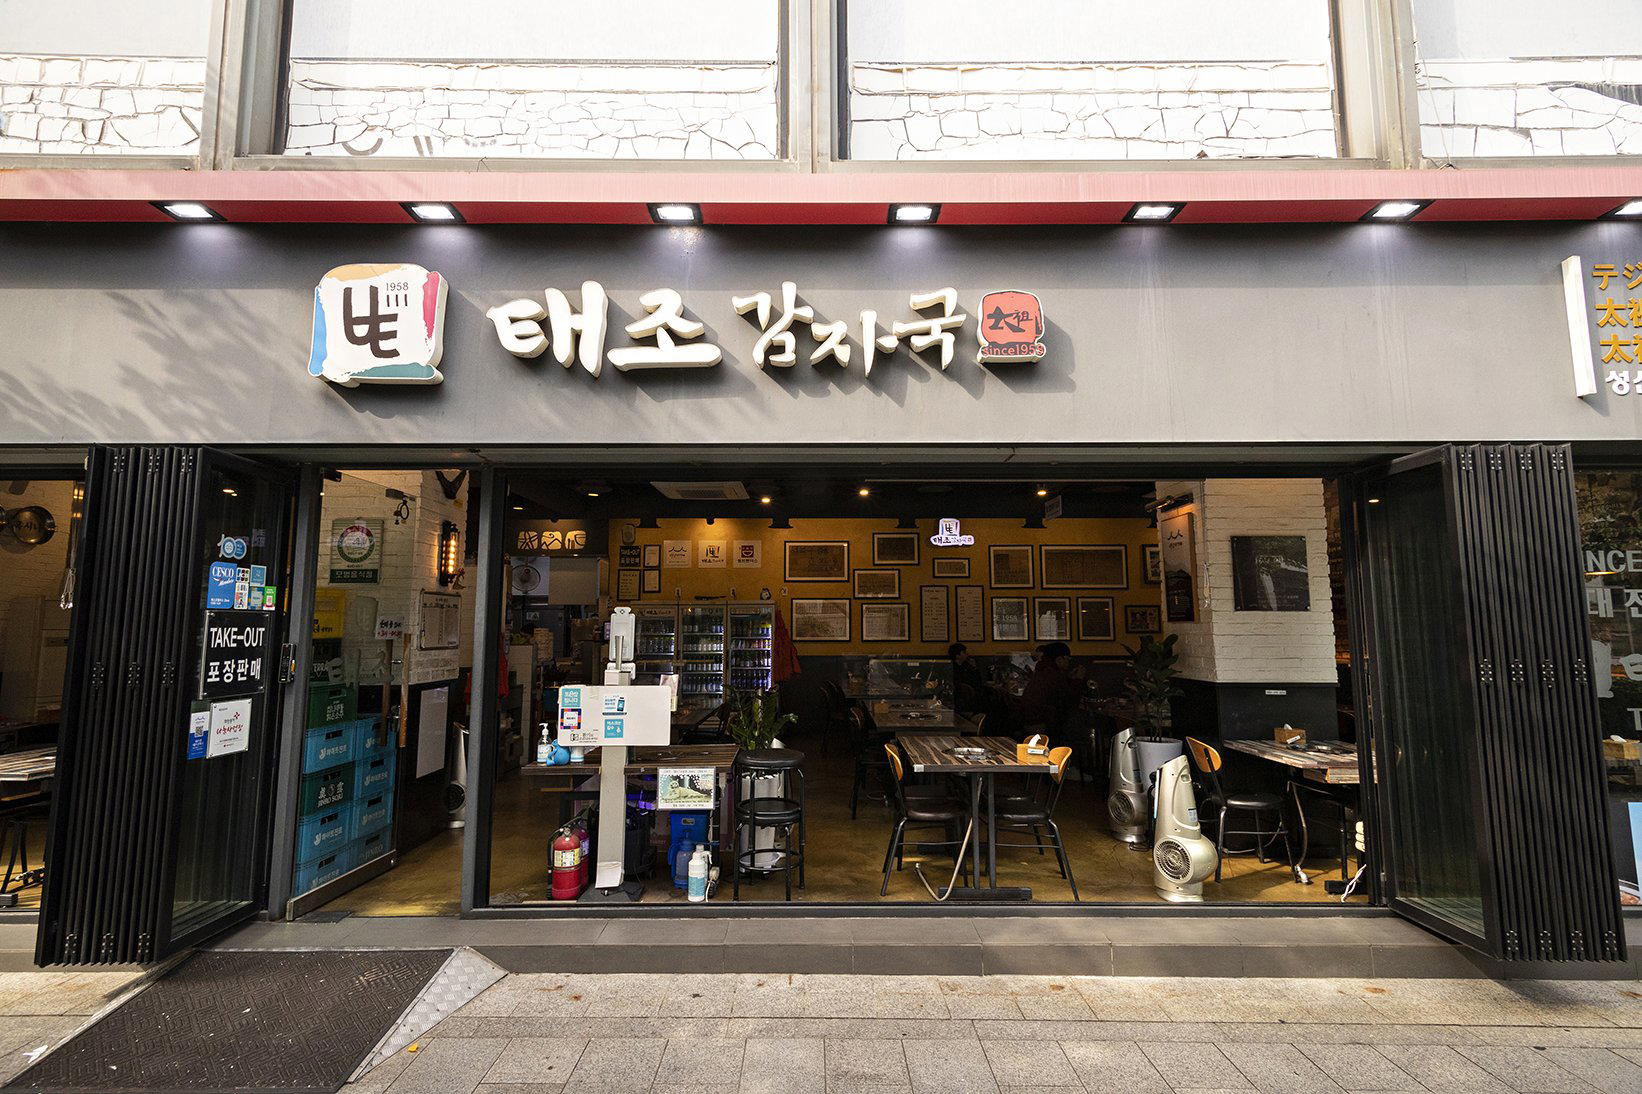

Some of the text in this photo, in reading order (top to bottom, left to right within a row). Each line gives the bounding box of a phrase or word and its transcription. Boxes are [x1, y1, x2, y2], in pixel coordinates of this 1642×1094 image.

[385, 281, 409, 291] 1958
[212, 566, 235, 578] CESCO
[209, 627, 266, 648] TAKE-OUT
[206, 657, 262, 683] 포장판매
